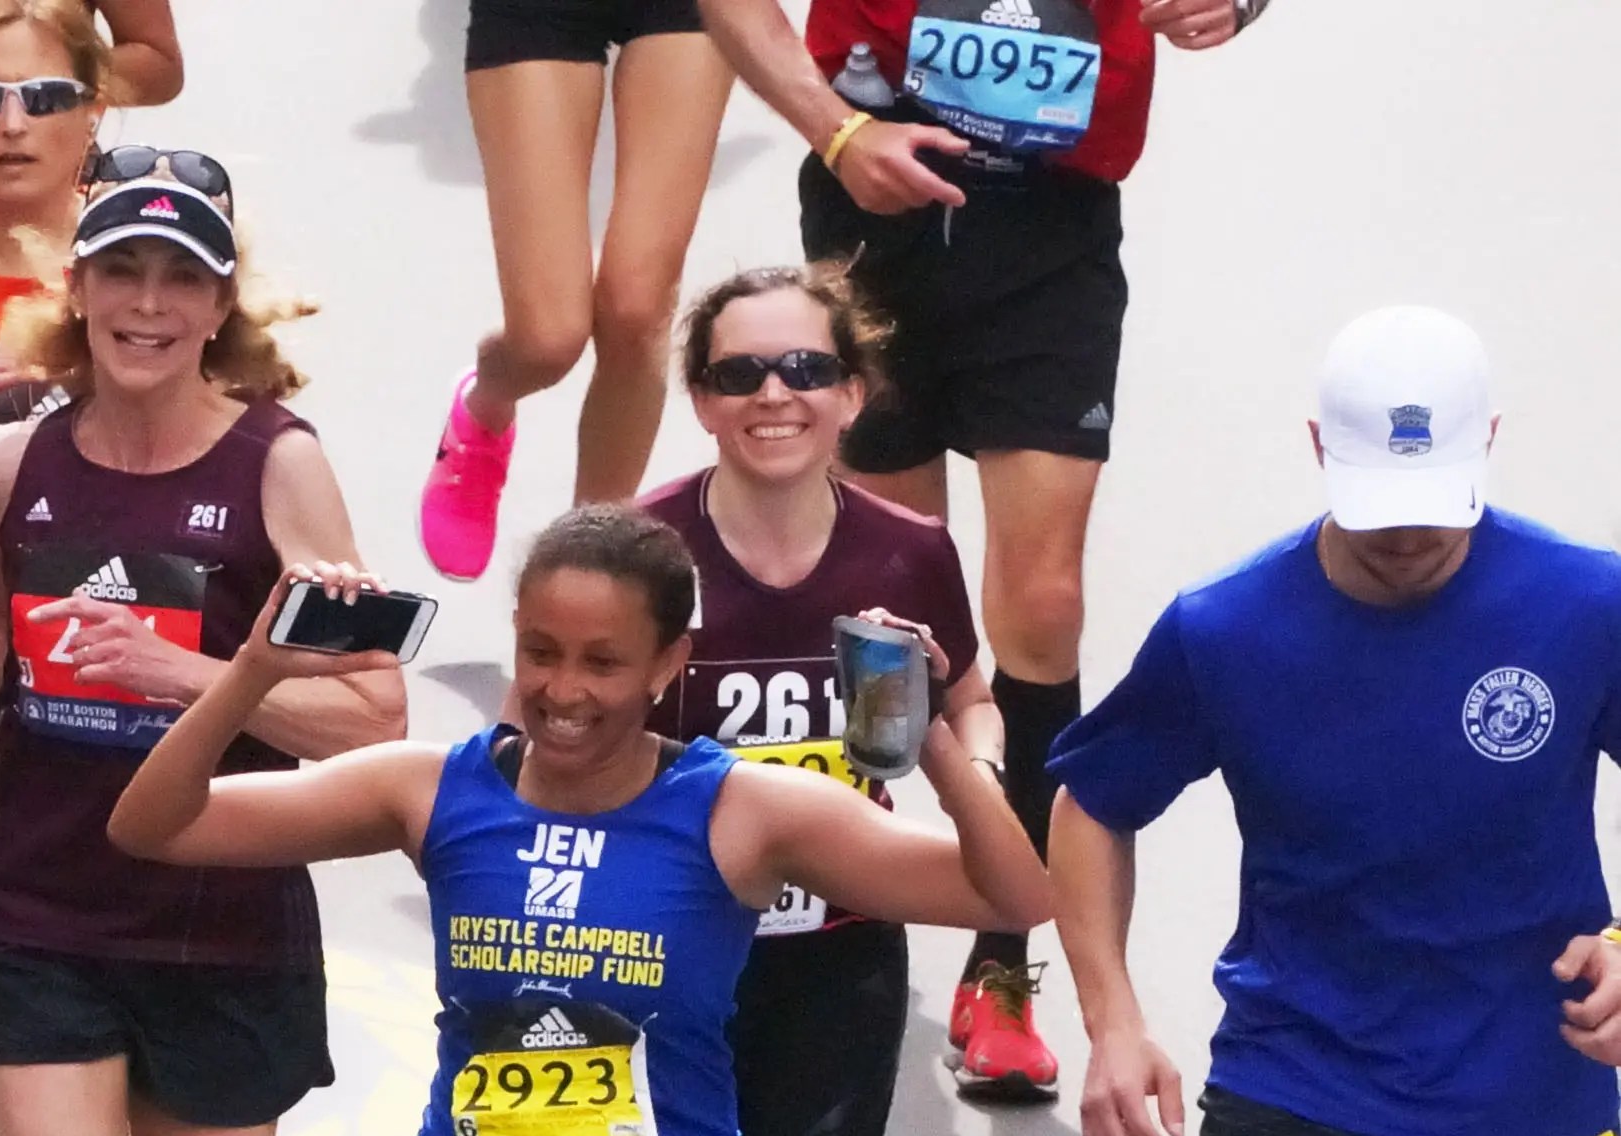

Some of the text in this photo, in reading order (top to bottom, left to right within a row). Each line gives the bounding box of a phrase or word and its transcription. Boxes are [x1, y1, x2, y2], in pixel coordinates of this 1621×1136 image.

[915, 28, 1097, 94] 20957
[909, 71, 924, 93] 5
[188, 504, 228, 531] 261
[80, 582, 138, 601] adidas
[74, 703, 117, 718] BOSTON
[716, 670, 847, 740] 261
[47, 712, 117, 731] MARATHON
[516, 823, 606, 868] JEN
[523, 904, 576, 920] UMASS
[449, 916, 666, 960] KRYSTLE CAMPBELL
[450, 943, 664, 987] SCHOLARSHIP FUND
[521, 1029, 587, 1049] adidas
[460, 1057, 636, 1113] 2923
